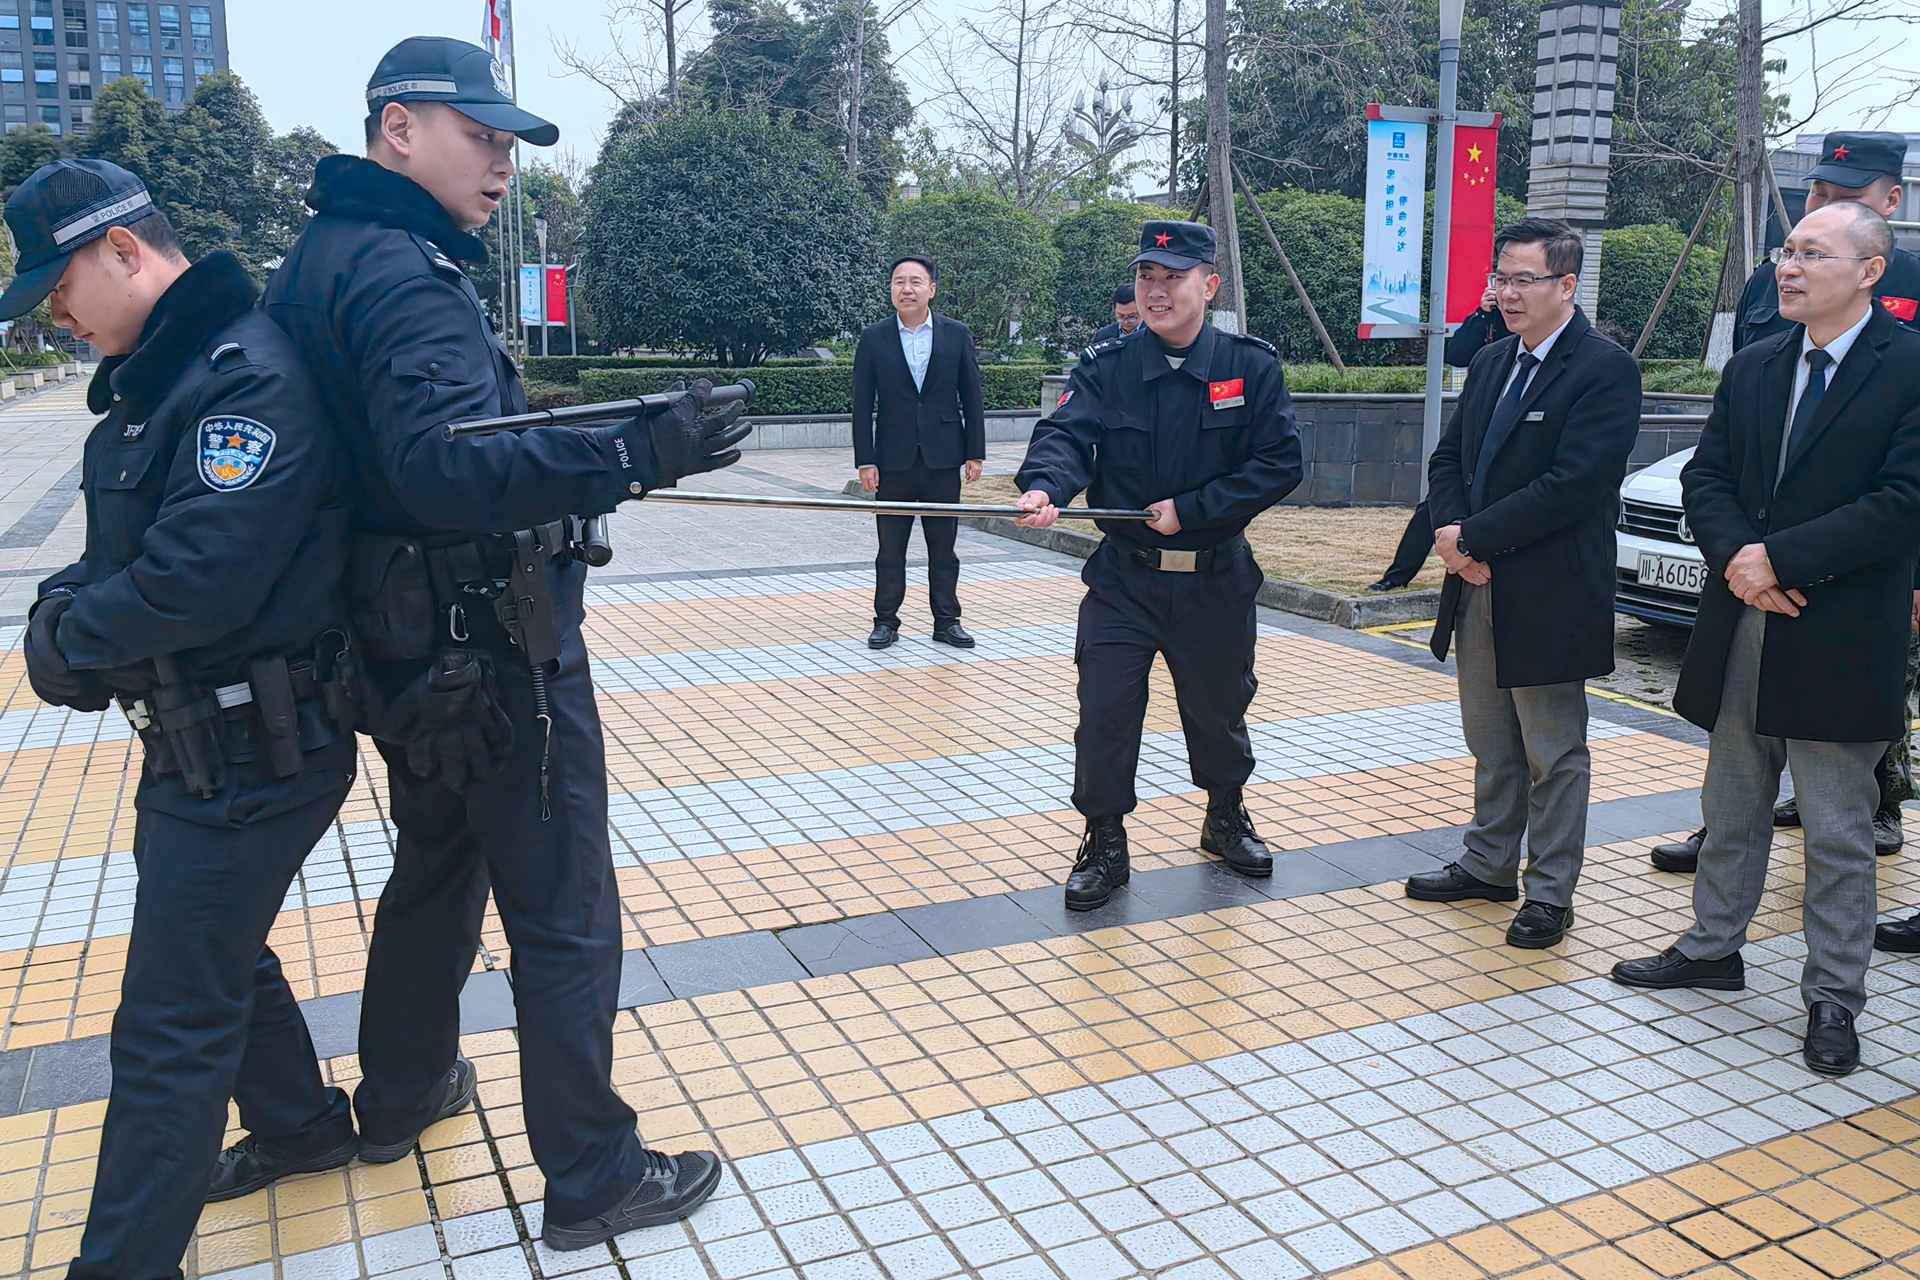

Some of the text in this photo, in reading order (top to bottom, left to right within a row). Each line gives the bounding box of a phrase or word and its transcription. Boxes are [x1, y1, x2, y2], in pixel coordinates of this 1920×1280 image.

[100, 203, 129, 220] POLICE
[1385, 168, 1395, 226] 忠诚担当
[1396, 195, 1408, 252] 使命必达
[204, 421, 272, 444] 中华人民共和国
[614, 437, 632, 469] POLICE
